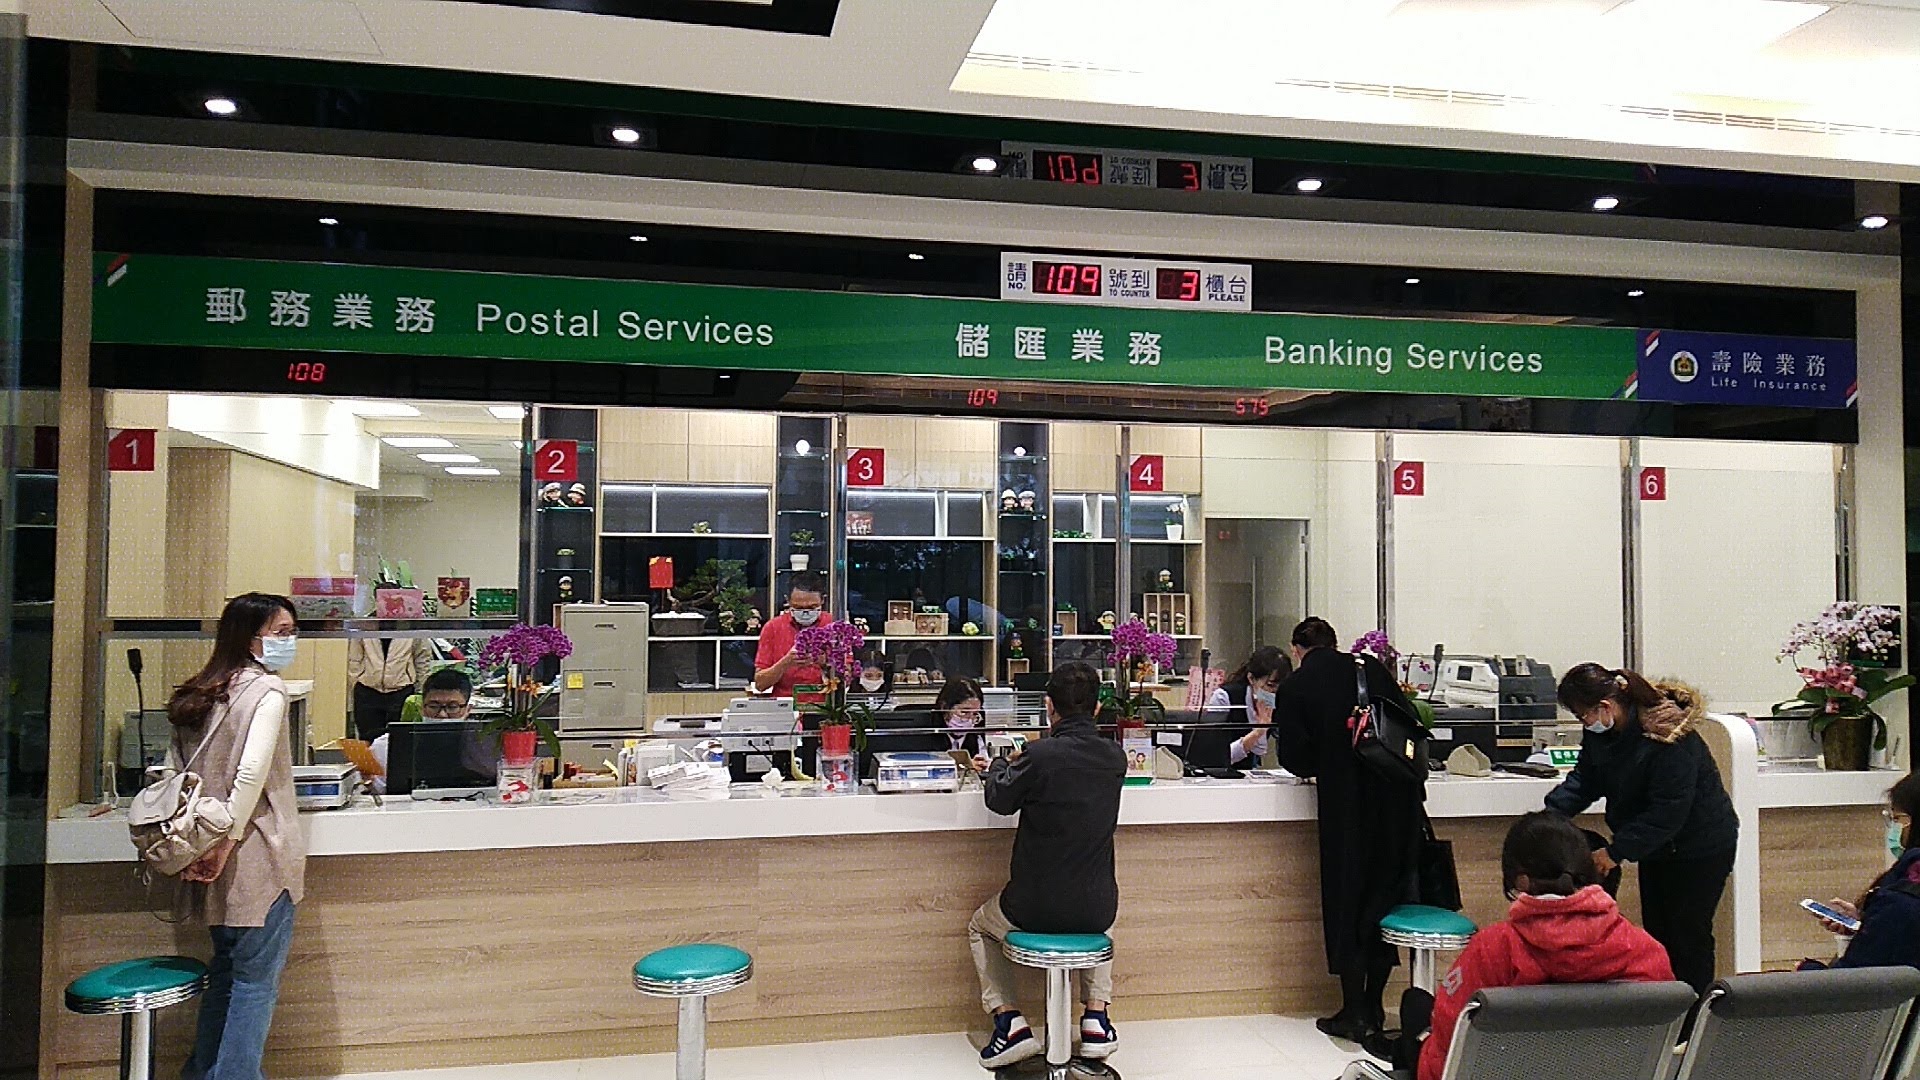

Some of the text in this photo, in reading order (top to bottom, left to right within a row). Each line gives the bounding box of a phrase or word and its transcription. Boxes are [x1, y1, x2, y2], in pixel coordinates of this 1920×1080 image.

[1007, 262, 1247, 299] 請 109 號到 3 櫃台
[1008, 282, 1245, 302] NO. TO COUNTER PLEASE
[205, 286, 436, 334] 郵務業務
[476, 303, 774, 346] Postal Services
[955, 322, 1163, 367] 儲匯業務
[1264, 336, 1544, 375] Banking Services
[287, 362, 326, 383] 108
[1711, 350, 1826, 377] 壽險業務
[1711, 377, 1827, 391] Life Insurance
[967, 389, 998, 407] 109
[125, 439, 138, 465] 1
[546, 450, 566, 474] 2
[858, 457, 875, 481] 3
[1138, 462, 1155, 486] 4
[1401, 470, 1416, 491] 5
[1645, 475, 1659, 495] 6
